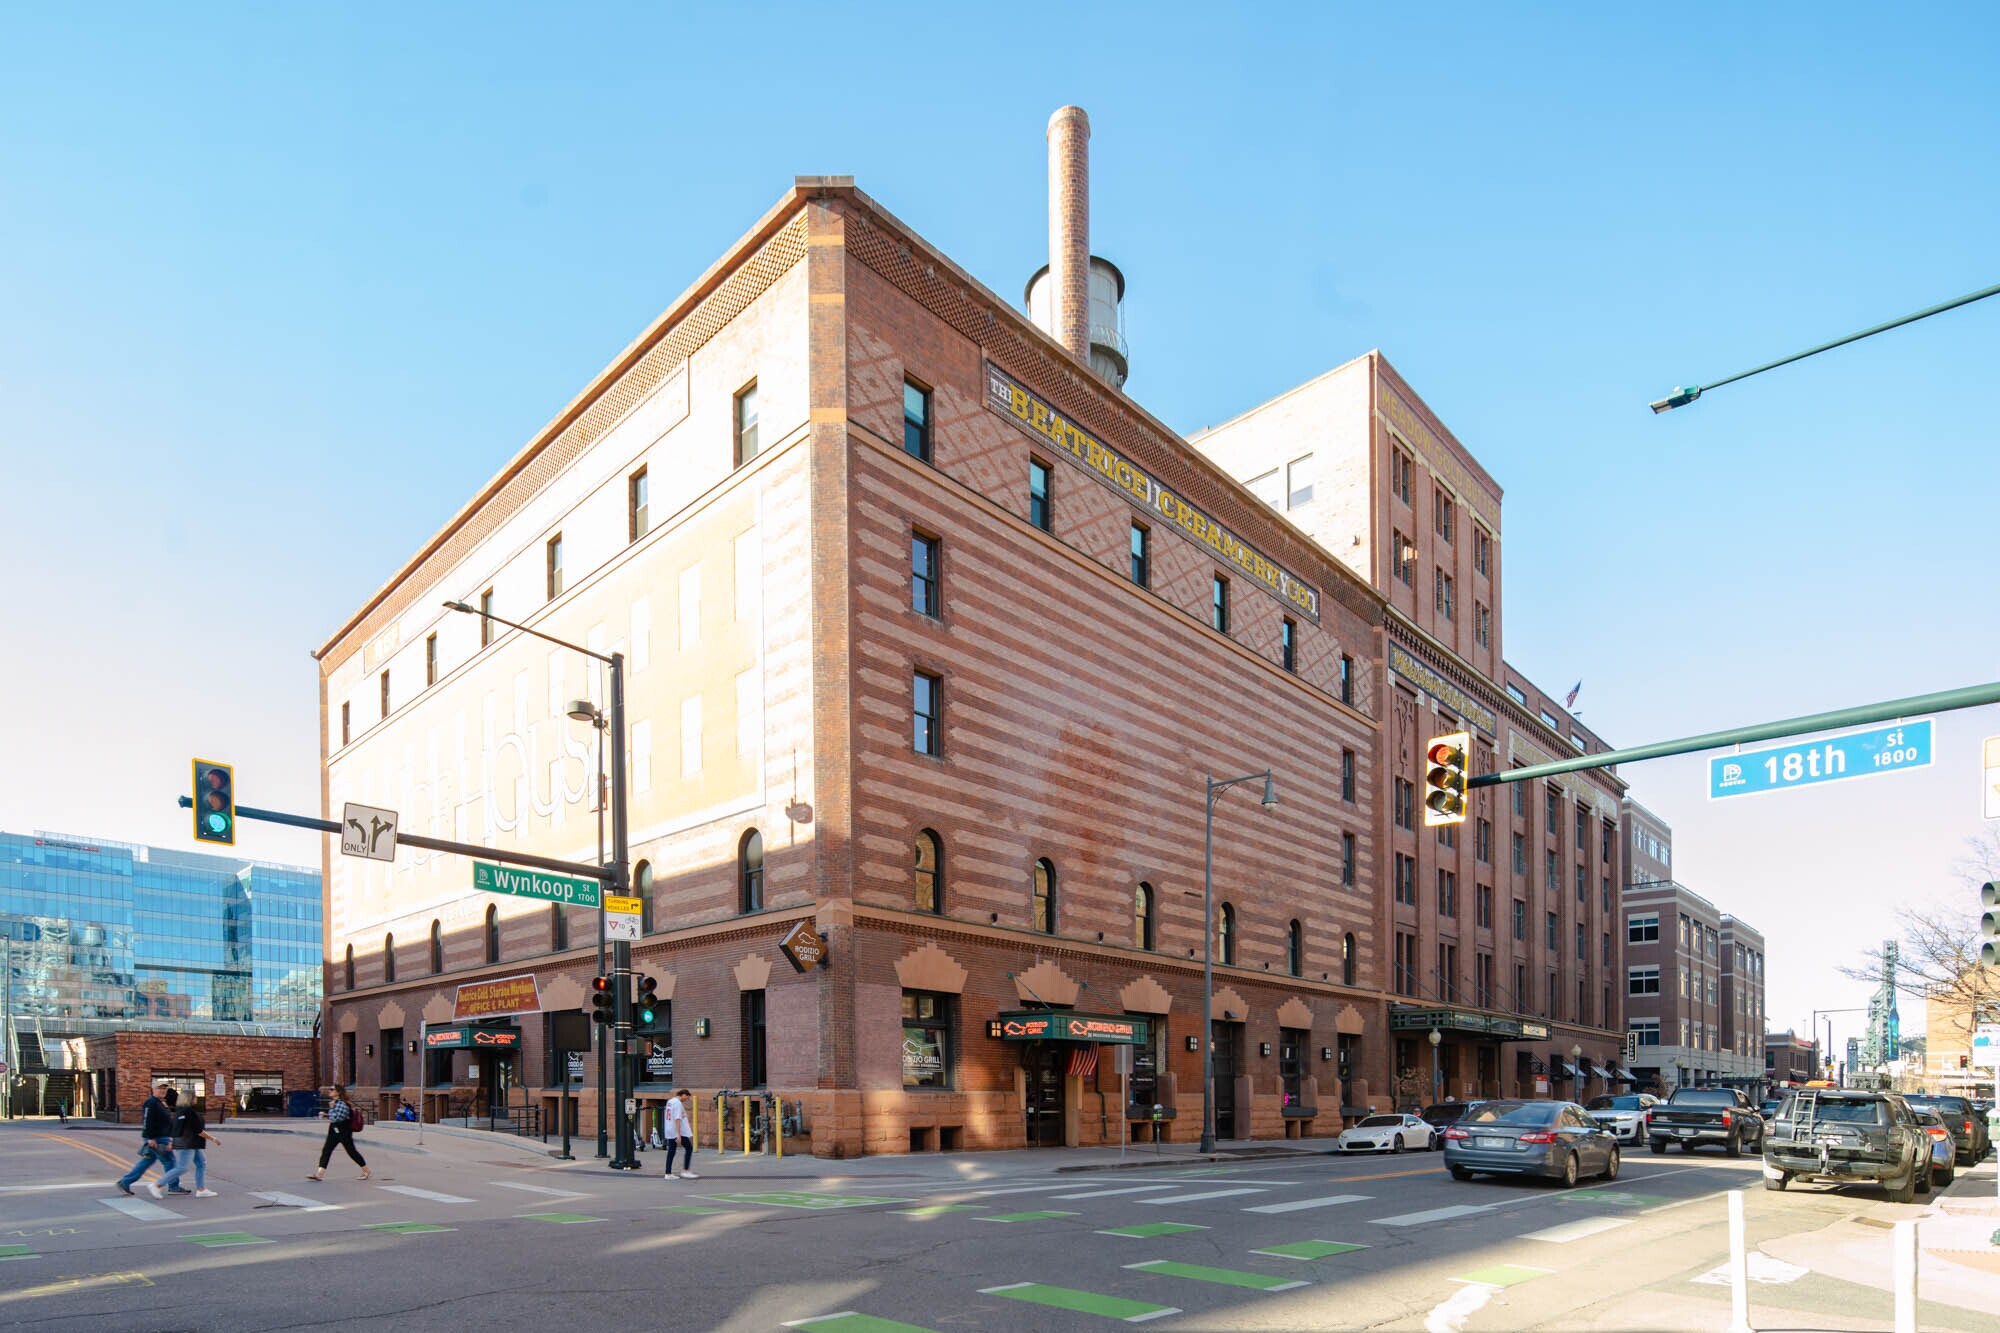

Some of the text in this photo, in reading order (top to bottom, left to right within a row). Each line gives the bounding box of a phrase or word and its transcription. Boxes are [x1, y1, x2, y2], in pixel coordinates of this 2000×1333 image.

[1381, 388, 1432, 456] MEADOW
[1434, 446, 1463, 487] GOLD
[1009, 383, 1148, 502] BEATRICE
[1159, 490, 1279, 590] CREAMERY
[1873, 747, 1918, 767] 1800
[1764, 744, 1846, 784] 18th
[344, 842, 367, 854] ONLY
[493, 869, 574, 902] Wynkoop
[582, 884, 590, 892] St
[577, 893, 596, 903] 1700
[795, 945, 820, 955] RODIZIO
[799, 954, 816, 962] GRILL
[469, 1000, 491, 1012] OFFICE
[497, 998, 520, 1009] PLANT
[924, 1055, 940, 1063] GRILL
